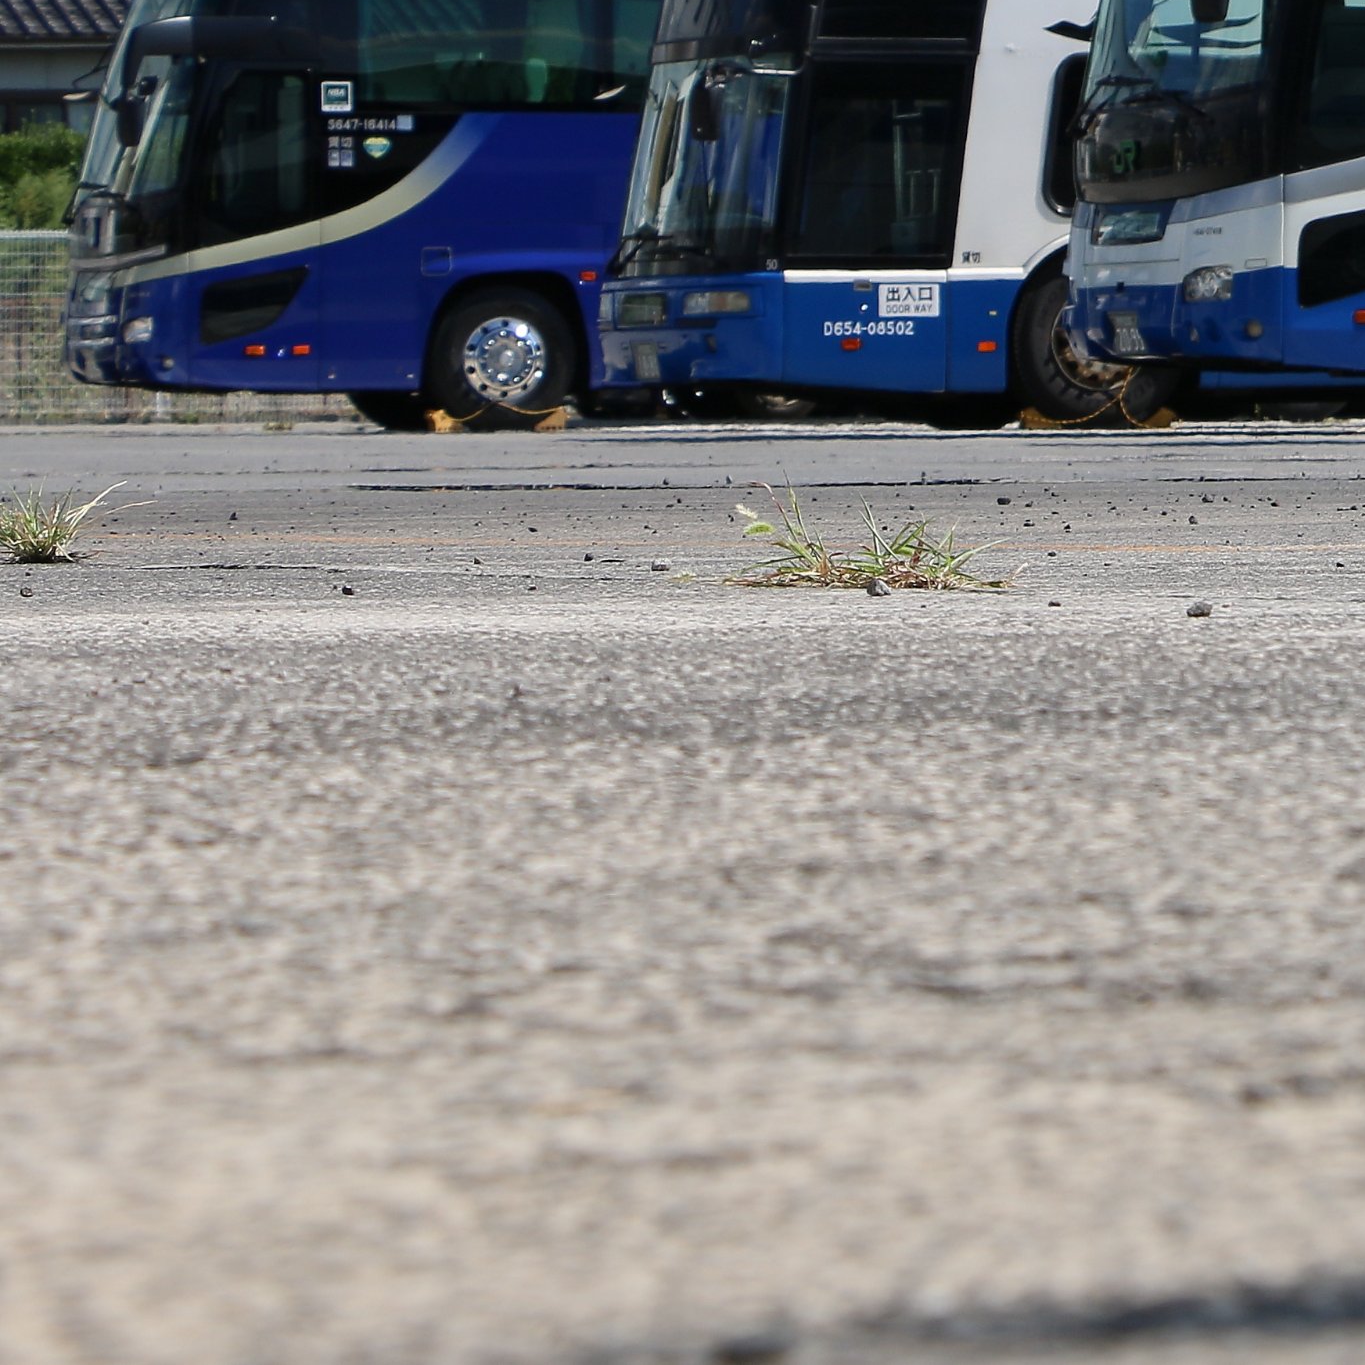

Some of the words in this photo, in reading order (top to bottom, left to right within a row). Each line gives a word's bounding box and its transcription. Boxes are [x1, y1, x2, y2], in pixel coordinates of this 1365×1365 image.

[886, 286, 933, 302] 出入口
[886, 303, 911, 314] DOOR
[913, 303, 933, 314] WAY
[823, 321, 914, 336] D654-08502
